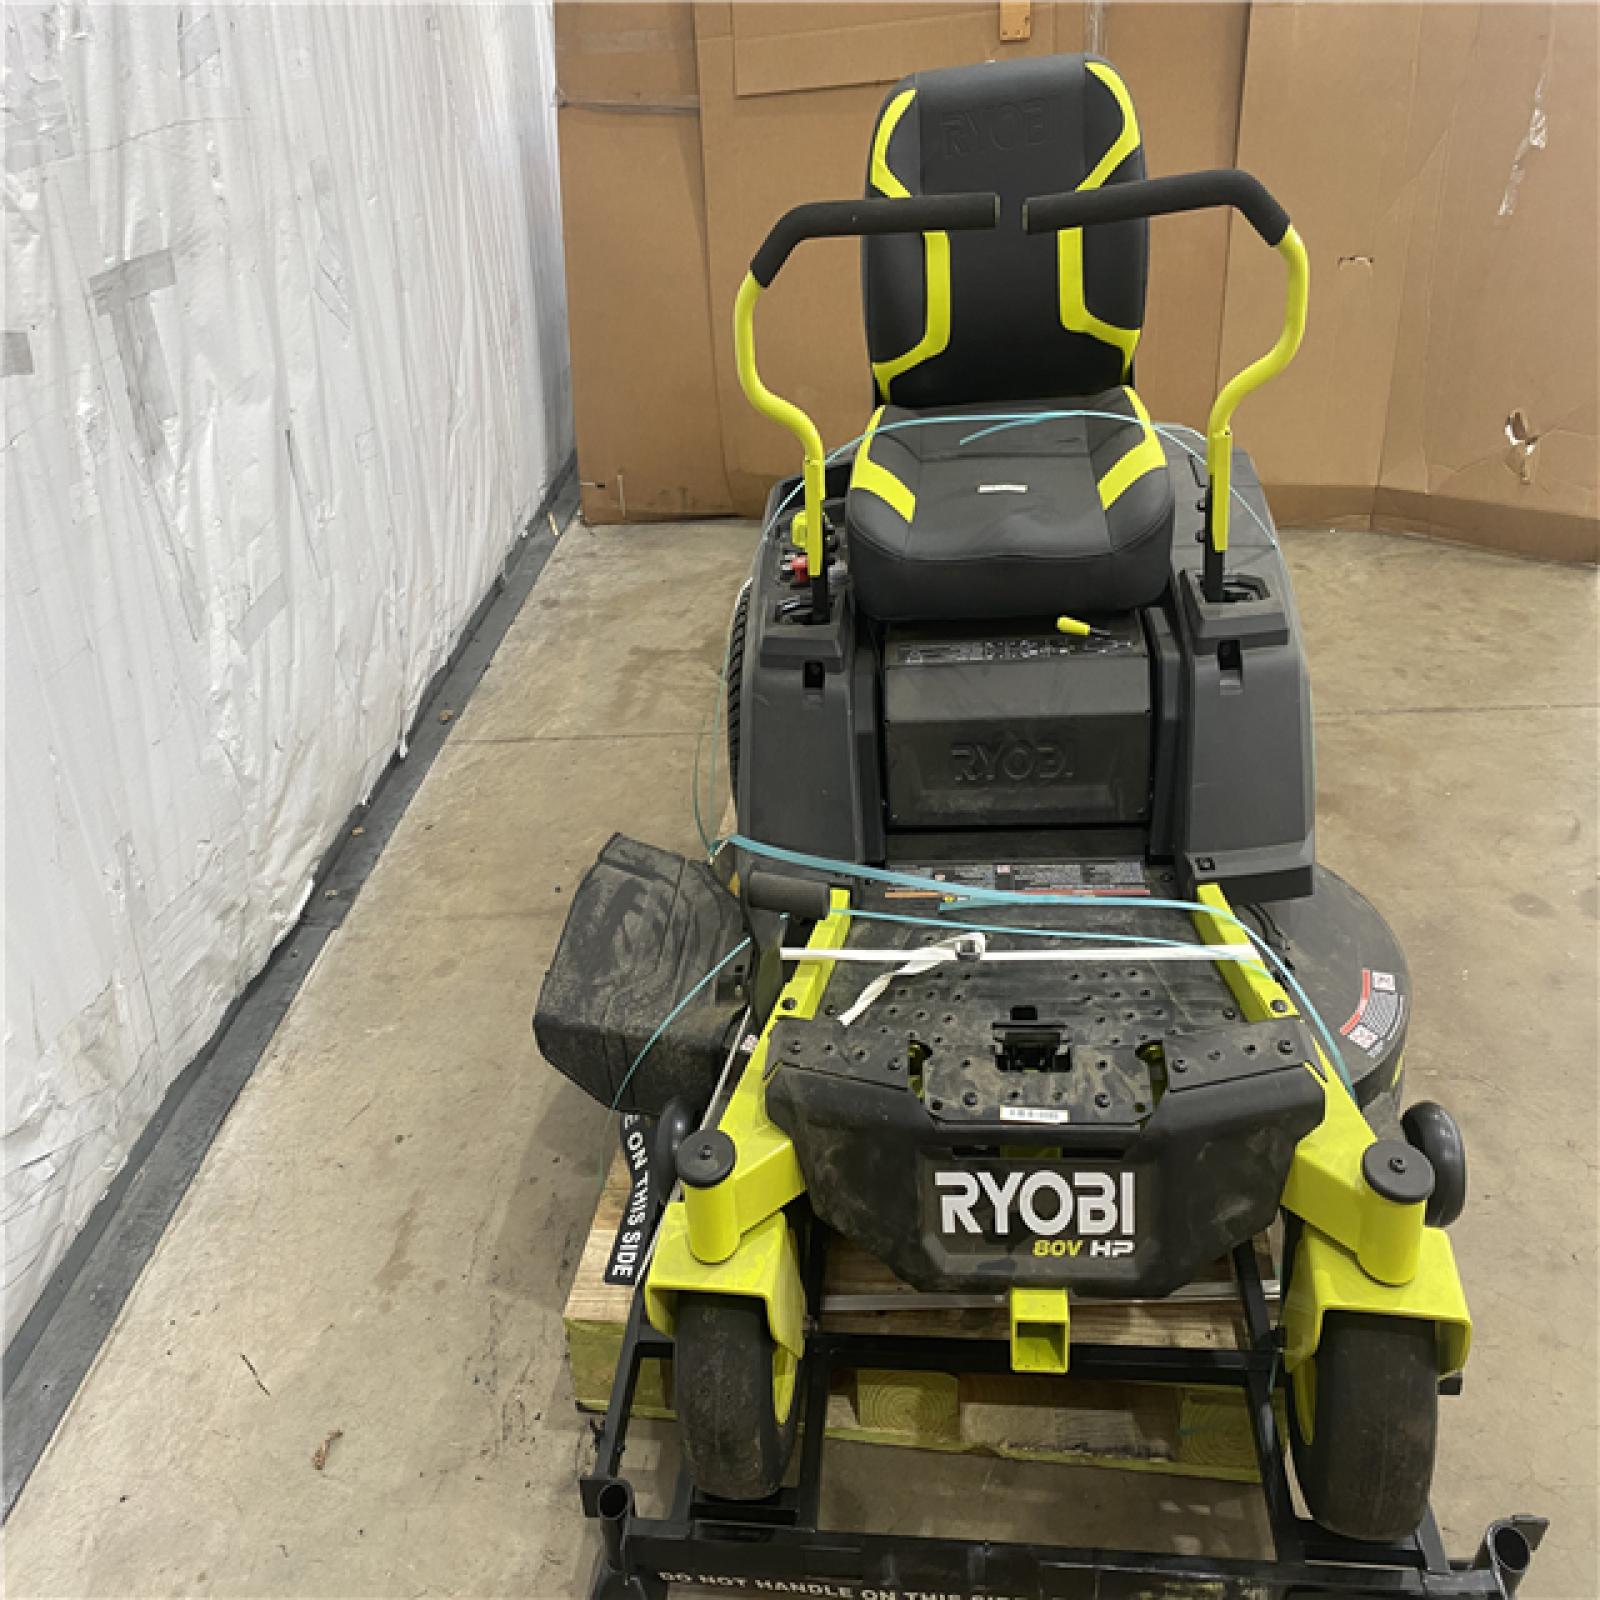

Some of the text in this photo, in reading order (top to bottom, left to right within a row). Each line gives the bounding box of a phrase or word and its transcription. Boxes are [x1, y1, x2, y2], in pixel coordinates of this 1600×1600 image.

[951, 741, 1074, 781] RYOBI
[627, 1131, 648, 1170] ON
[627, 1170, 648, 1226] THIS
[934, 1170, 1136, 1236] RYOBI
[612, 1230, 641, 1277] SIDE
[1032, 1240, 1136, 1257] 80V HP
[754, 1579, 853, 1598] HANDLE
